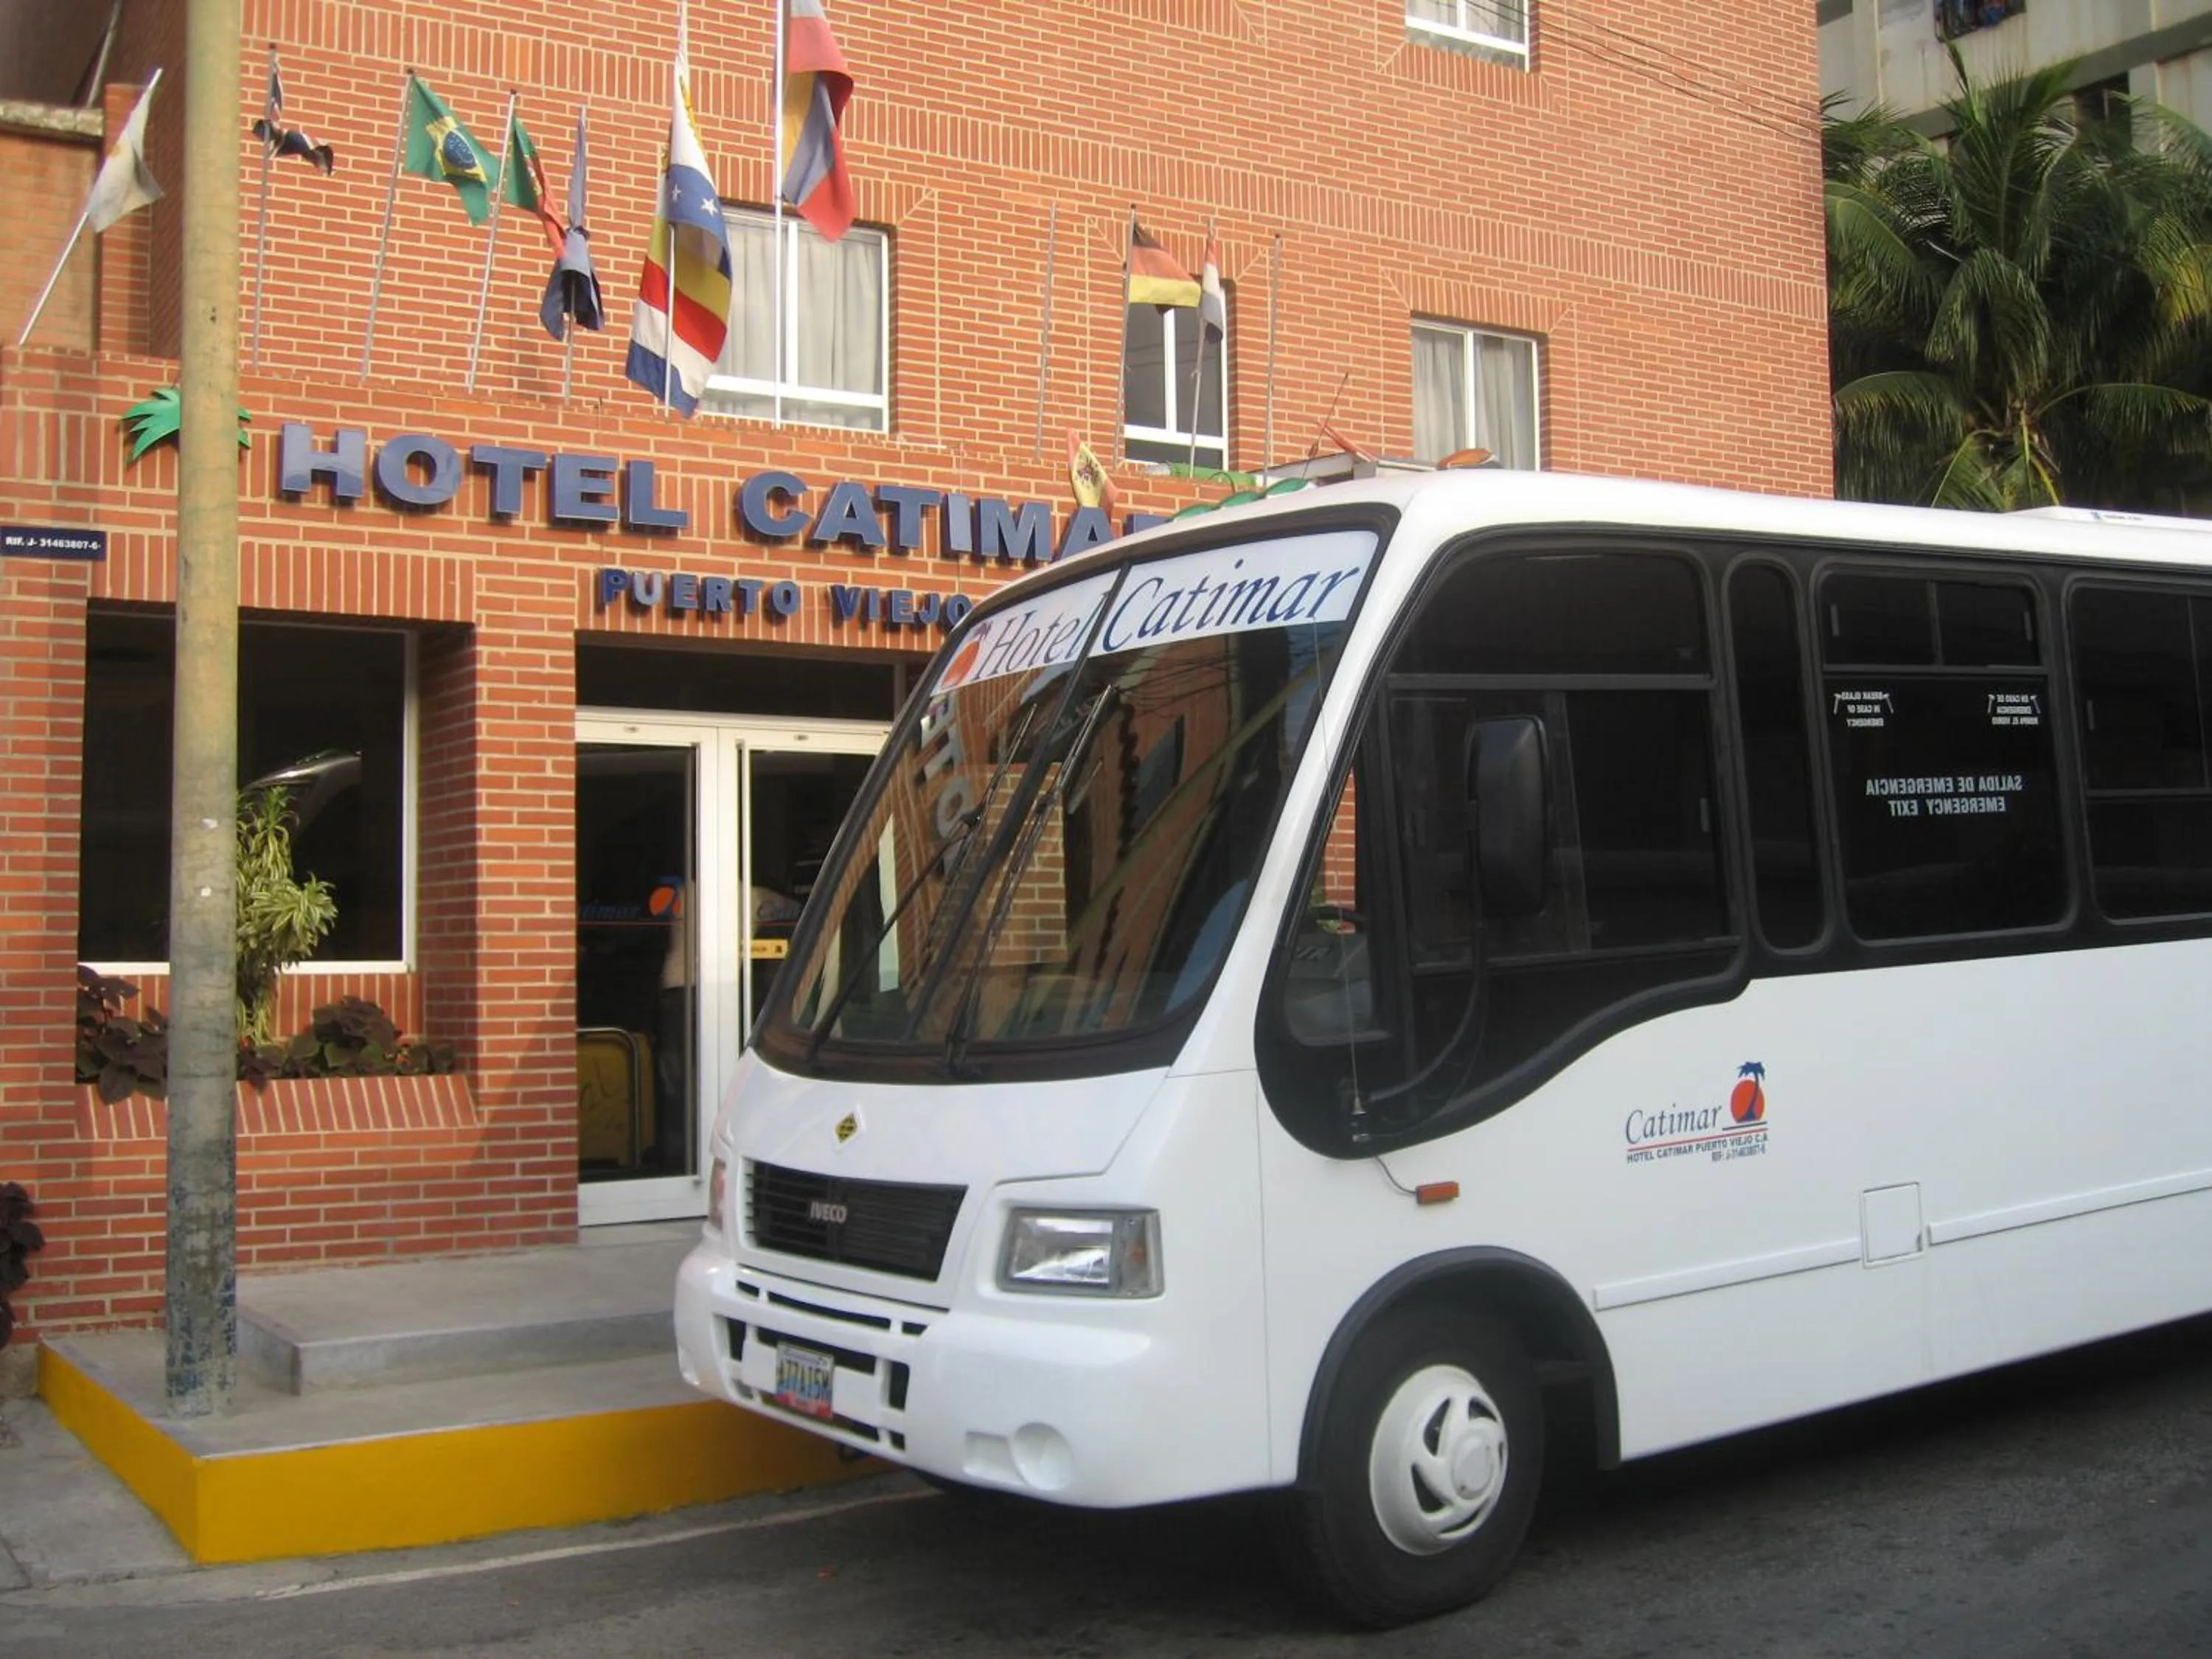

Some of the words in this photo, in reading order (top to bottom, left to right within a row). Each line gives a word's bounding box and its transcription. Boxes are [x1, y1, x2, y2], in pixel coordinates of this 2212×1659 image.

[279, 422, 688, 528] HOTEL
[5, 535, 24, 546] RIF.
[600, 567, 801, 615] PUERTO
[832, 585, 973, 631] VIEJO
[972, 593, 1109, 681] Hotel
[1102, 558, 1360, 653] Catimar
[1625, 1103, 1723, 1145] Catimar
[1627, 1151, 1655, 1164] HOTEL
[1657, 1144, 1694, 1159] CATIMAR
[1695, 1138, 1728, 1153] PUERTO
[1729, 1135, 1753, 1148] VIEJO
[810, 1200, 848, 1224] IVECO
